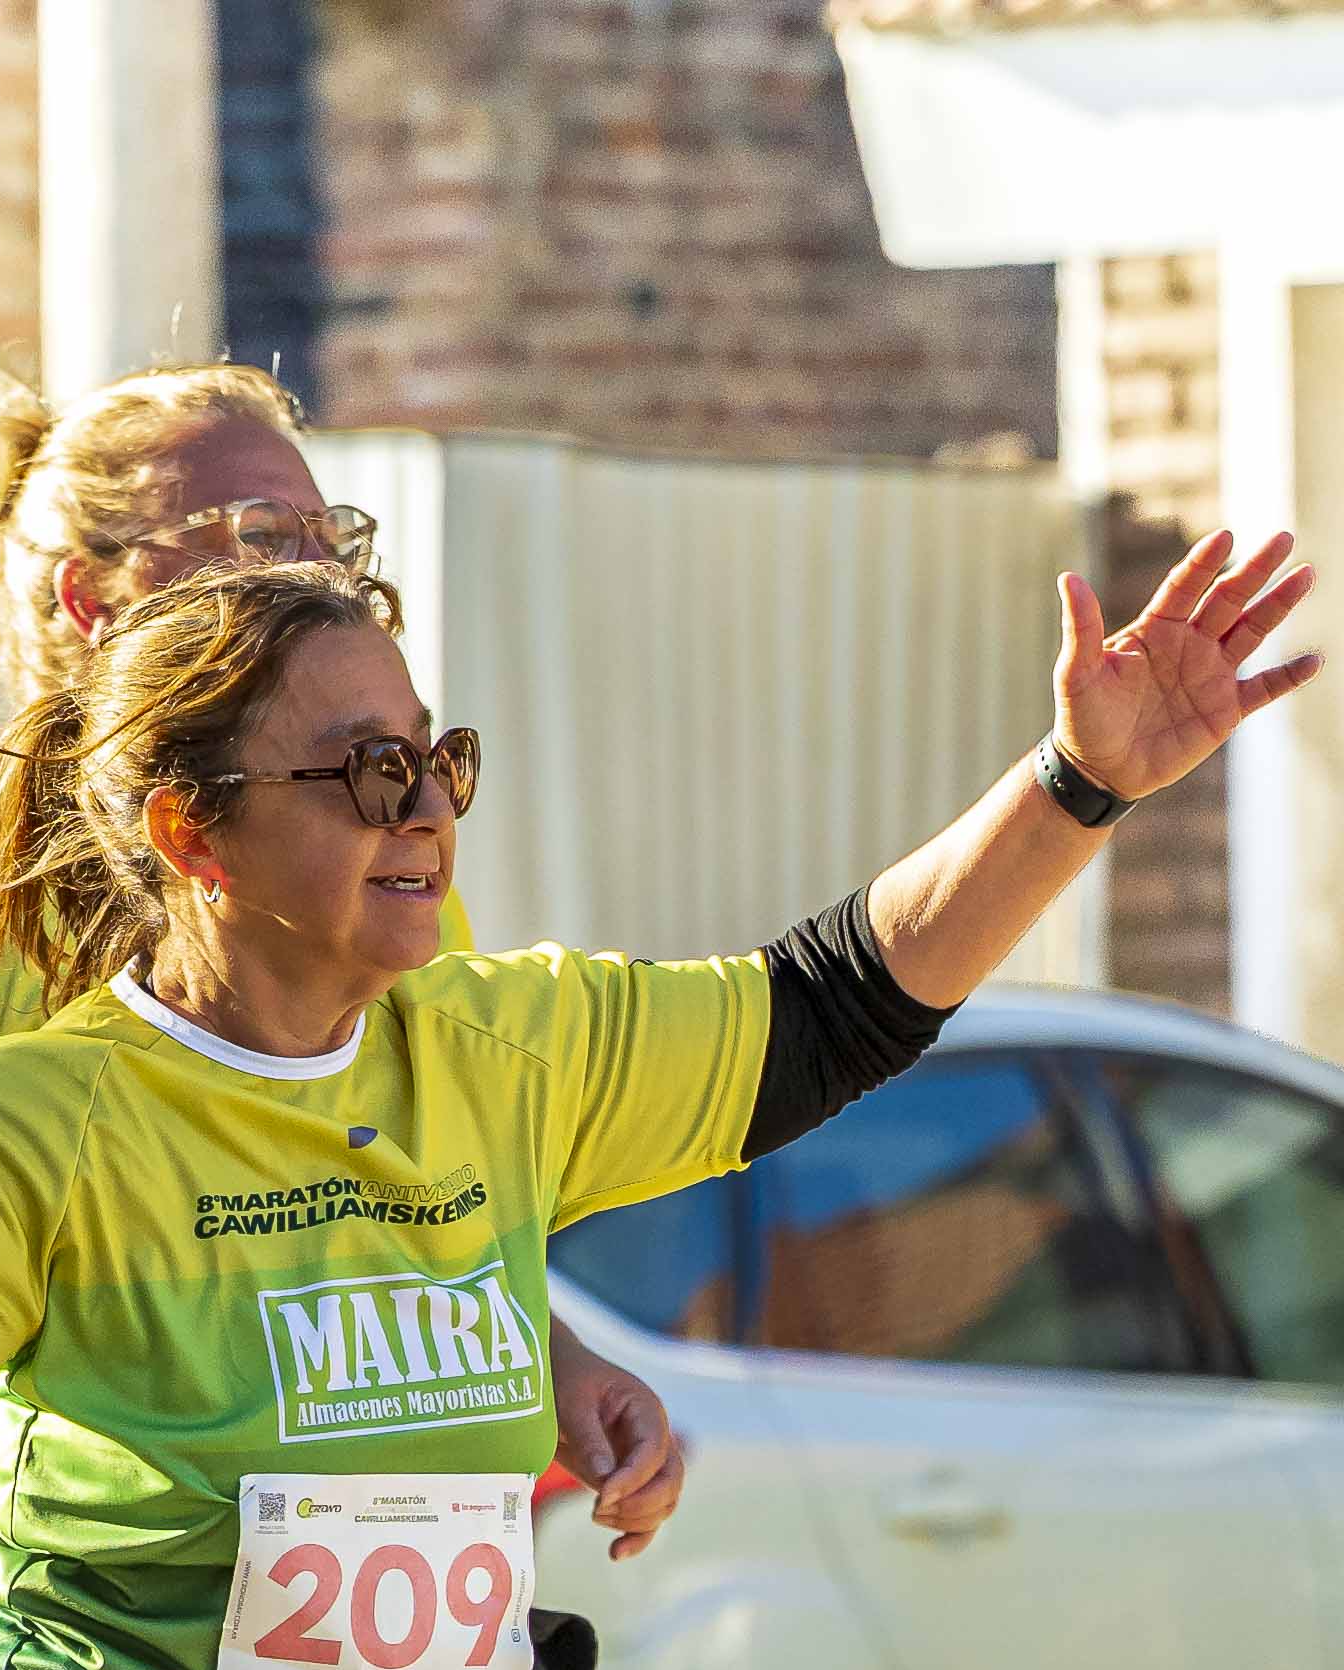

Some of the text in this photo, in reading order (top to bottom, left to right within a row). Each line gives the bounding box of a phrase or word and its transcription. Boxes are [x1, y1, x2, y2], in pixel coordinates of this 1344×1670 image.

[277, 1276, 534, 1394] MAIRA
[297, 1376, 536, 1427] Almacenes Mayoristas S.A.
[254, 1543, 513, 1670] 209
